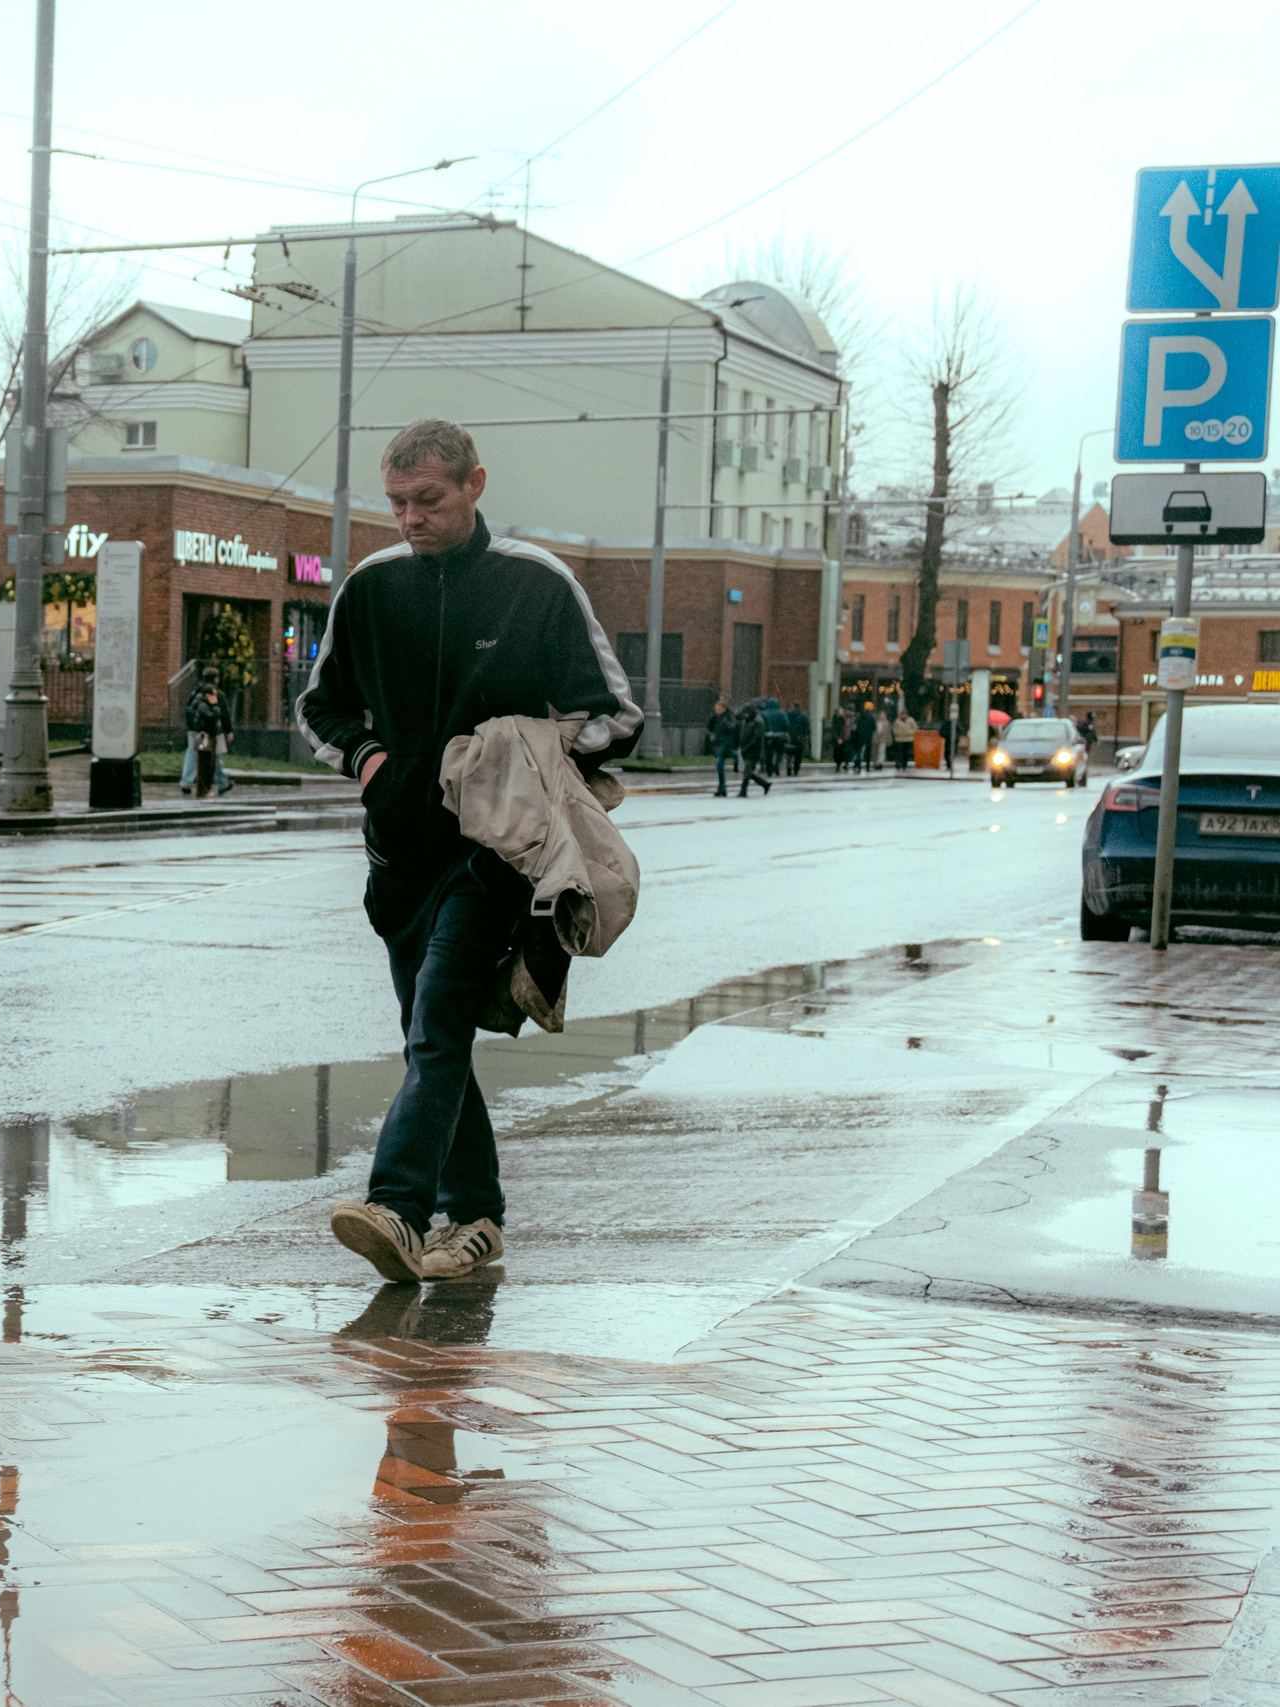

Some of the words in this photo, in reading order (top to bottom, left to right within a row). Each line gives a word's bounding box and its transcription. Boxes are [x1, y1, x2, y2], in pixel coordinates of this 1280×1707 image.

[1143, 335, 1228, 447] P
[1190, 425, 1200, 436] 10
[1207, 424, 1220, 437] 15
[1226, 422, 1250, 438] 20
[64, 524, 109, 558] fix
[173, 530, 216, 566] ЦВЕТЫ
